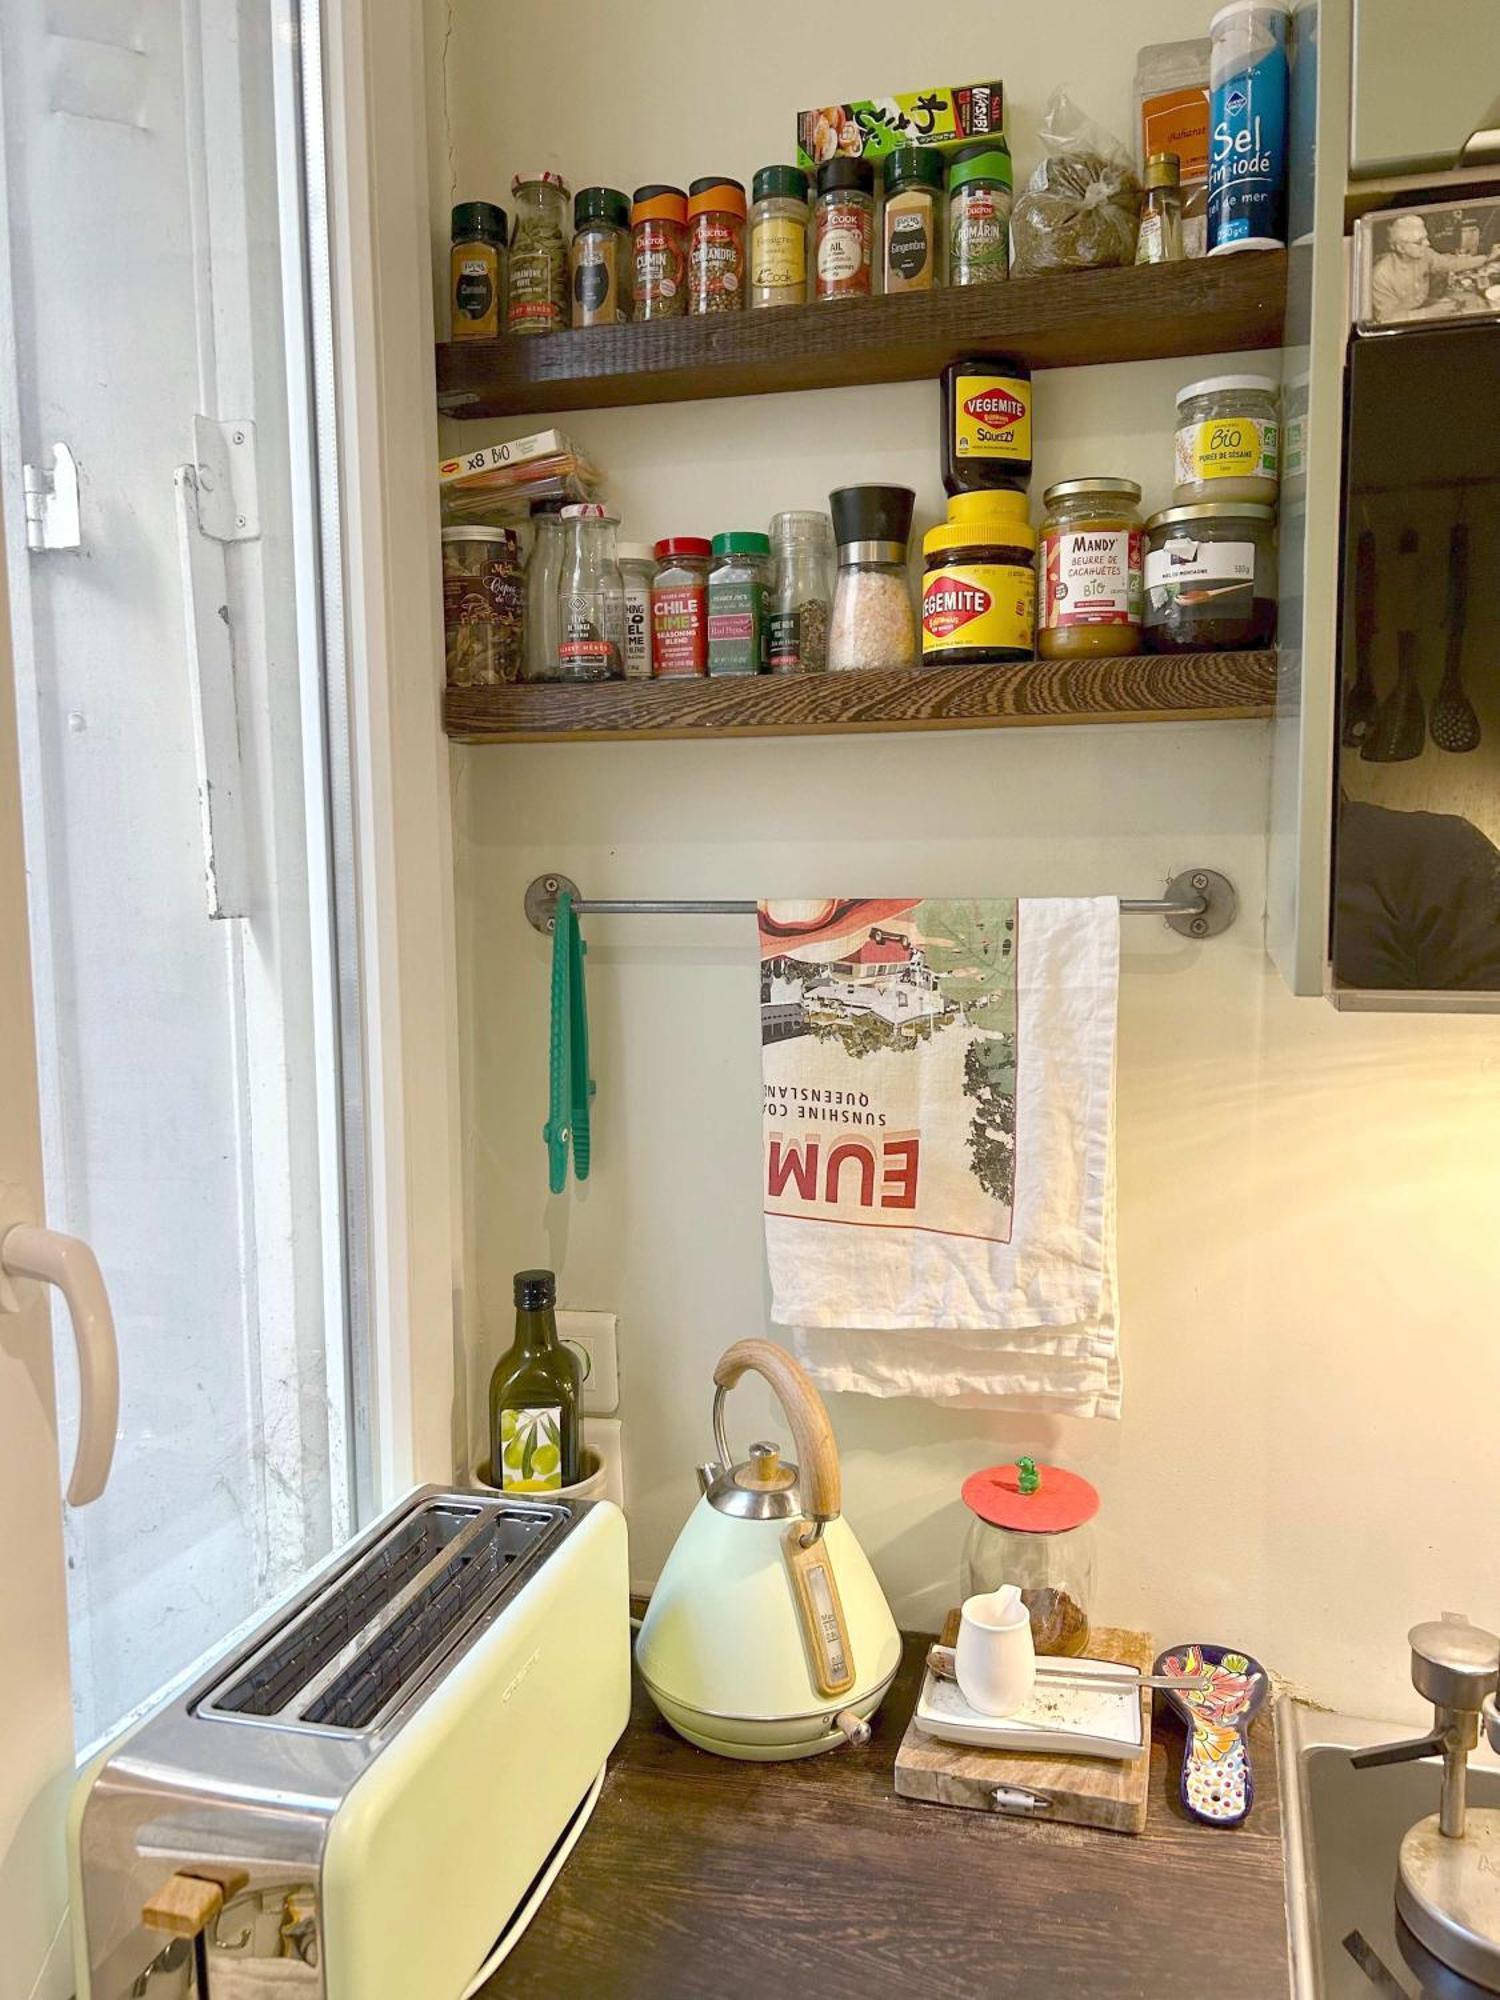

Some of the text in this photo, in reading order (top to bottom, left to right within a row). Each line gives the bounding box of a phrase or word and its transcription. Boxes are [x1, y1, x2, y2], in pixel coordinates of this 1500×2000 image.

[972, 87, 991, 133] WASABI
[854, 93, 949, 147] わさび
[1213, 114, 1261, 161] Sel
[1232, 151, 1272, 175] iodé
[1241, 193, 1269, 204] mer
[831, 215, 858, 225] COOK
[958, 224, 1001, 240] ROMARIN
[830, 243, 844, 253] AIL
[636, 253, 669, 269] CUMIN
[967, 397, 1024, 418] VEGEMITE
[467, 452, 485, 471] x8
[1071, 555, 1119, 567] BEURRE DE
[654, 599, 698, 616] CHILE
[922, 591, 985, 618] EGEMITE
[654, 615, 690, 632] LIME
[797, 1105, 886, 1126] SUNSHINE
[767, 1138, 920, 1209] EUM
